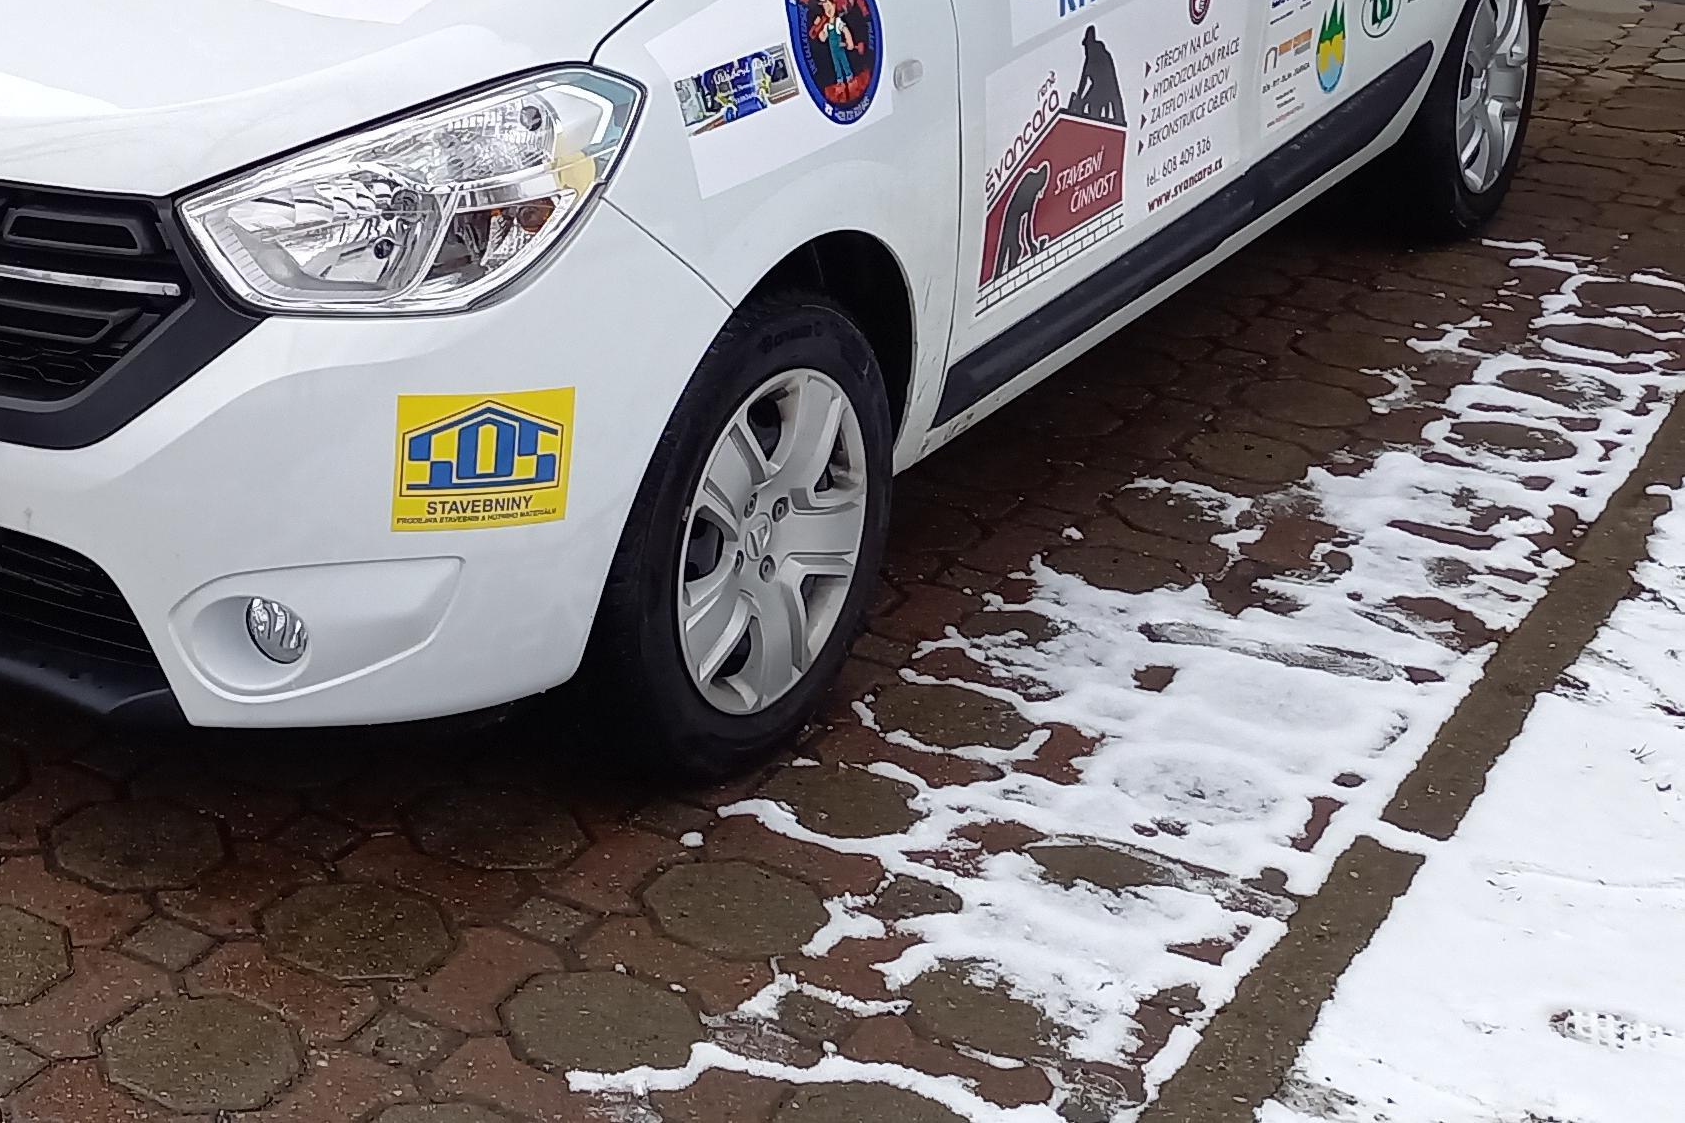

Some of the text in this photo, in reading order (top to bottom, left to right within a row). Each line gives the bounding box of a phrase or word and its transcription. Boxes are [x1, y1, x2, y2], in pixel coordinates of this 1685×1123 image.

[1155, 41, 1189, 73] STŘECHY
[1190, 36, 1201, 56] NA
[1147, 101, 1206, 148] REKONSTRUKCE
[1054, 145, 1105, 195] STAVEBNÍ
[1070, 170, 1117, 212] ČINNOST
[426, 495, 533, 515] STAVEBNINY
